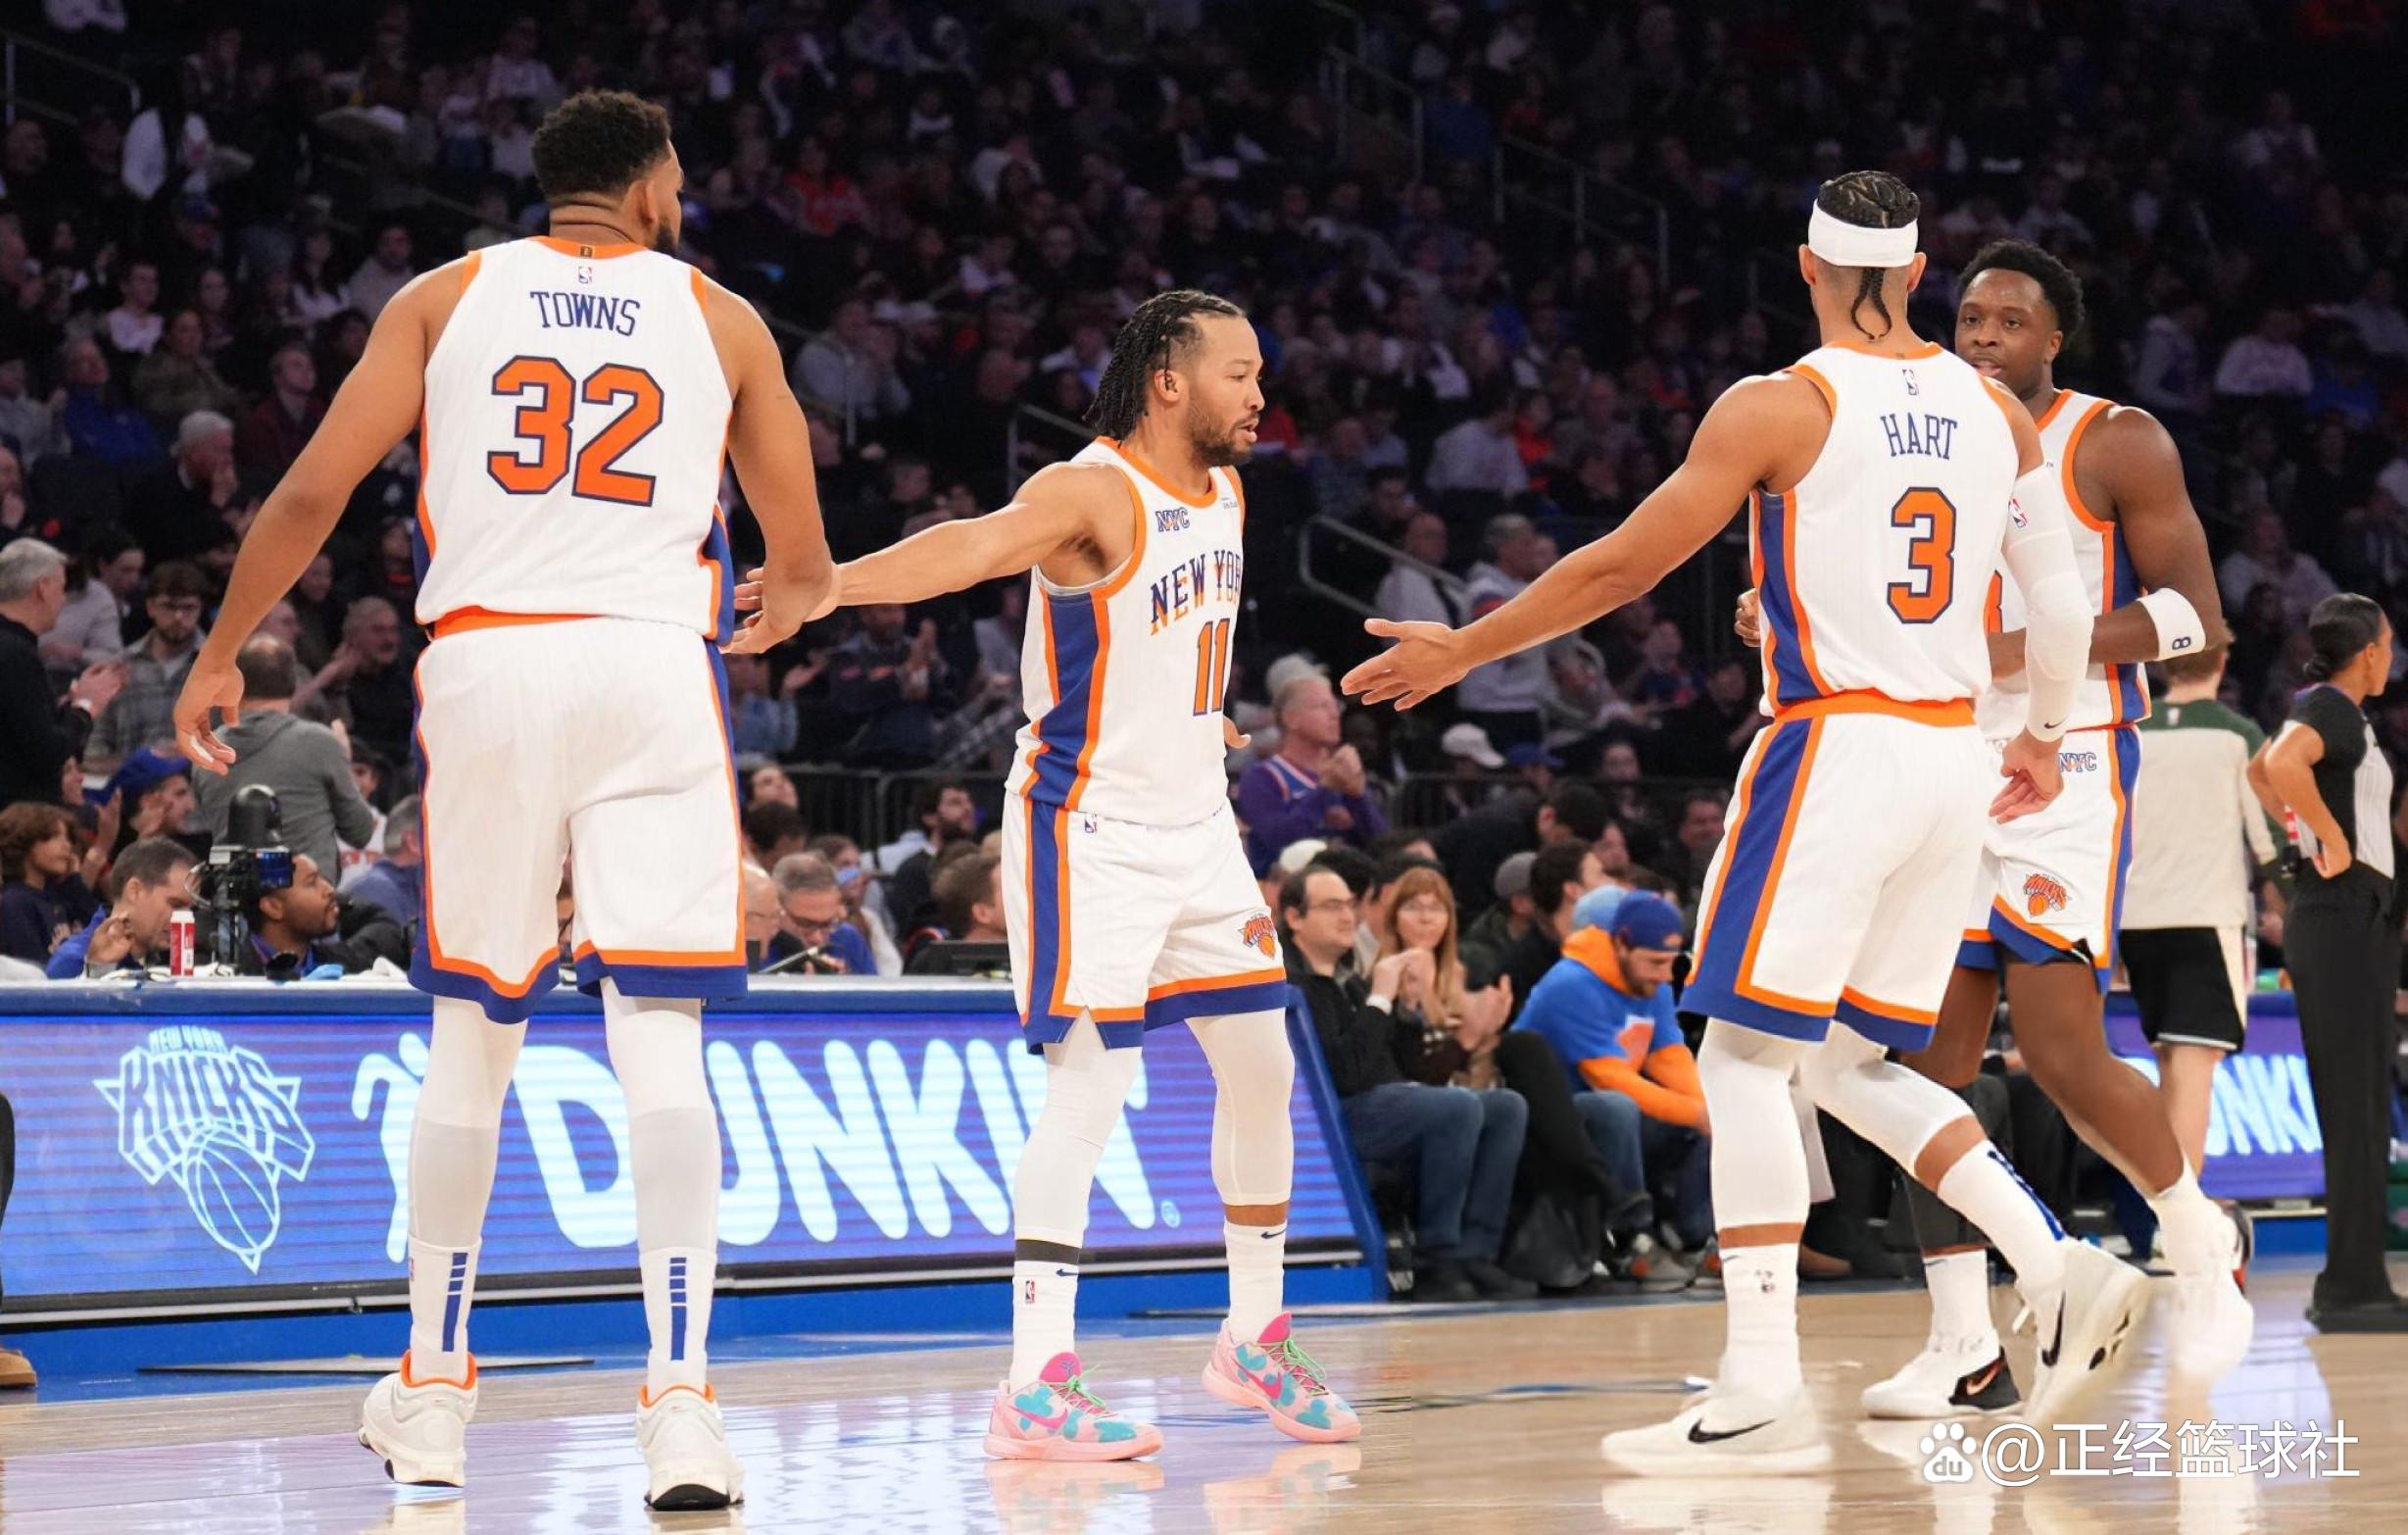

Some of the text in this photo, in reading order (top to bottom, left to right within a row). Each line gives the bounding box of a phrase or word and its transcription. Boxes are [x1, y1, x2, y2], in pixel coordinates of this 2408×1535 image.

[529, 291, 641, 337] TOWNS
[486, 355, 664, 507] 32
[1880, 413, 1958, 461] HART
[1155, 507, 1191, 532] NYC
[1887, 486, 1957, 624] 3
[1150, 549, 1242, 632] NEW YOR
[1193, 618, 1231, 717] 11
[2058, 751, 2098, 772] NYC
[118, 1041, 315, 1176] KNICKS
